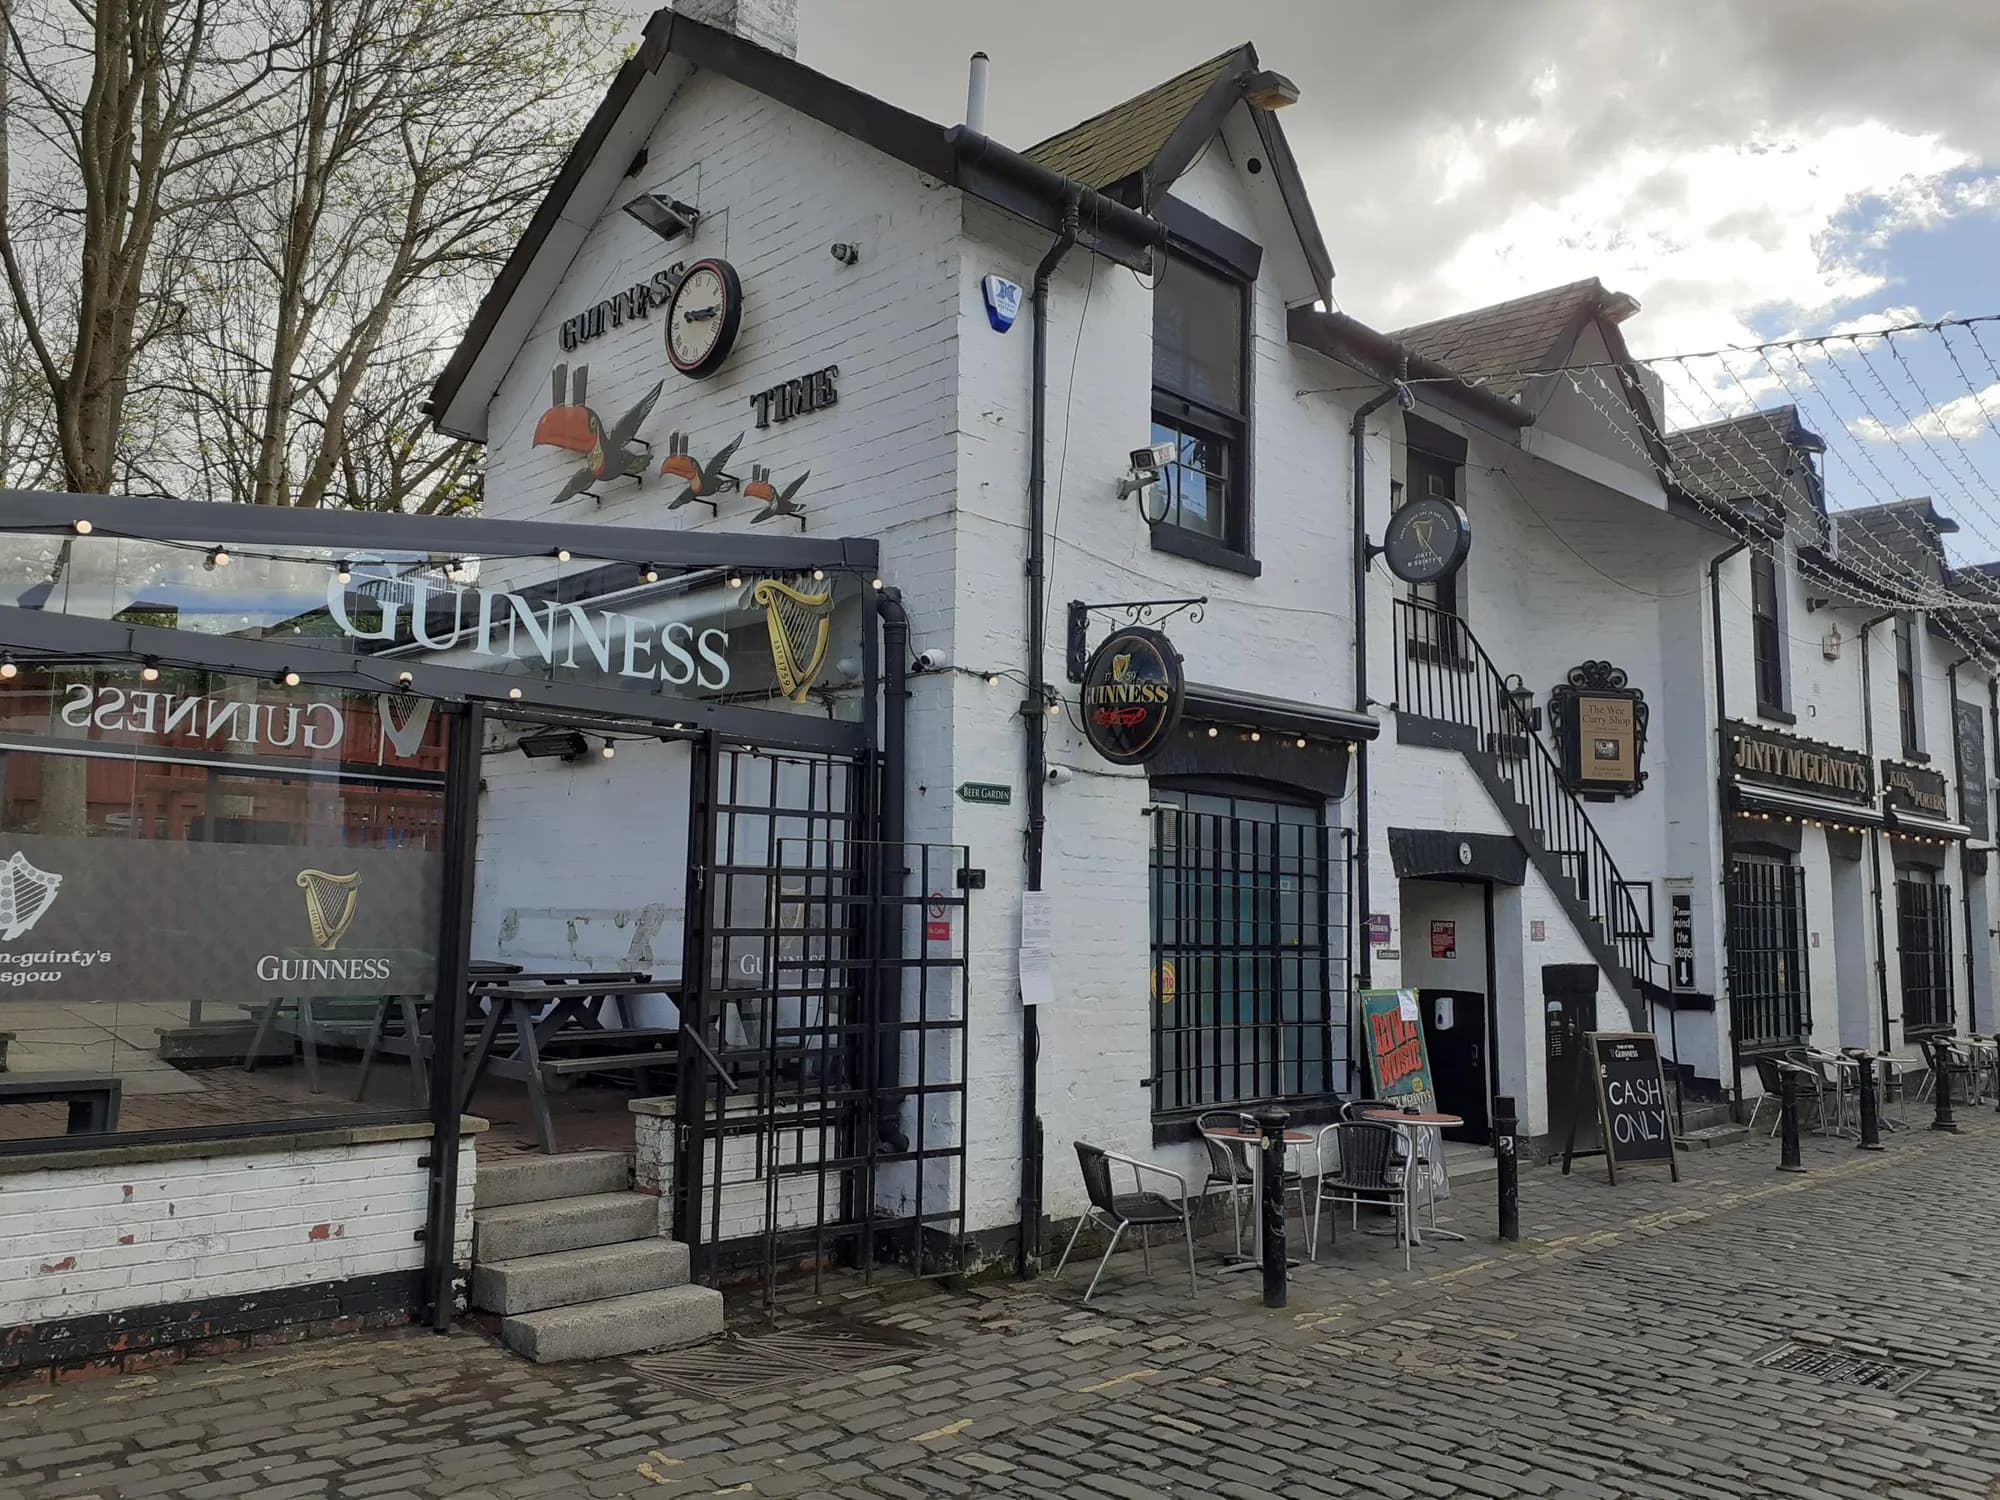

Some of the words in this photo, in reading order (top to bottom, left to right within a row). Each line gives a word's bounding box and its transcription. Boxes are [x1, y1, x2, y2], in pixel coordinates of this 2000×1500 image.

[559, 261, 685, 351] GUINNESS
[751, 365, 839, 429] TIME
[327, 552, 730, 690] GUINNESS
[777, 661, 791, 687] 1759
[1582, 714, 1607, 727] Curry
[1609, 716, 1631, 728] Shop
[1589, 704, 1604, 714] The
[1605, 705, 1625, 715] Wee
[963, 786, 981, 798] BEER
[981, 787, 1010, 800] GARDEN
[1673, 918, 1691, 929] mind
[1676, 931, 1689, 944] the
[1674, 945, 1694, 961] steps
[0, 971, 62, 986] sgow
[256, 955, 390, 981] GUINNESS
[1377, 1040, 1424, 1090] MUSIC
[1608, 1078, 1662, 1105] CASH
[1614, 1110, 1665, 1143] ONLY
